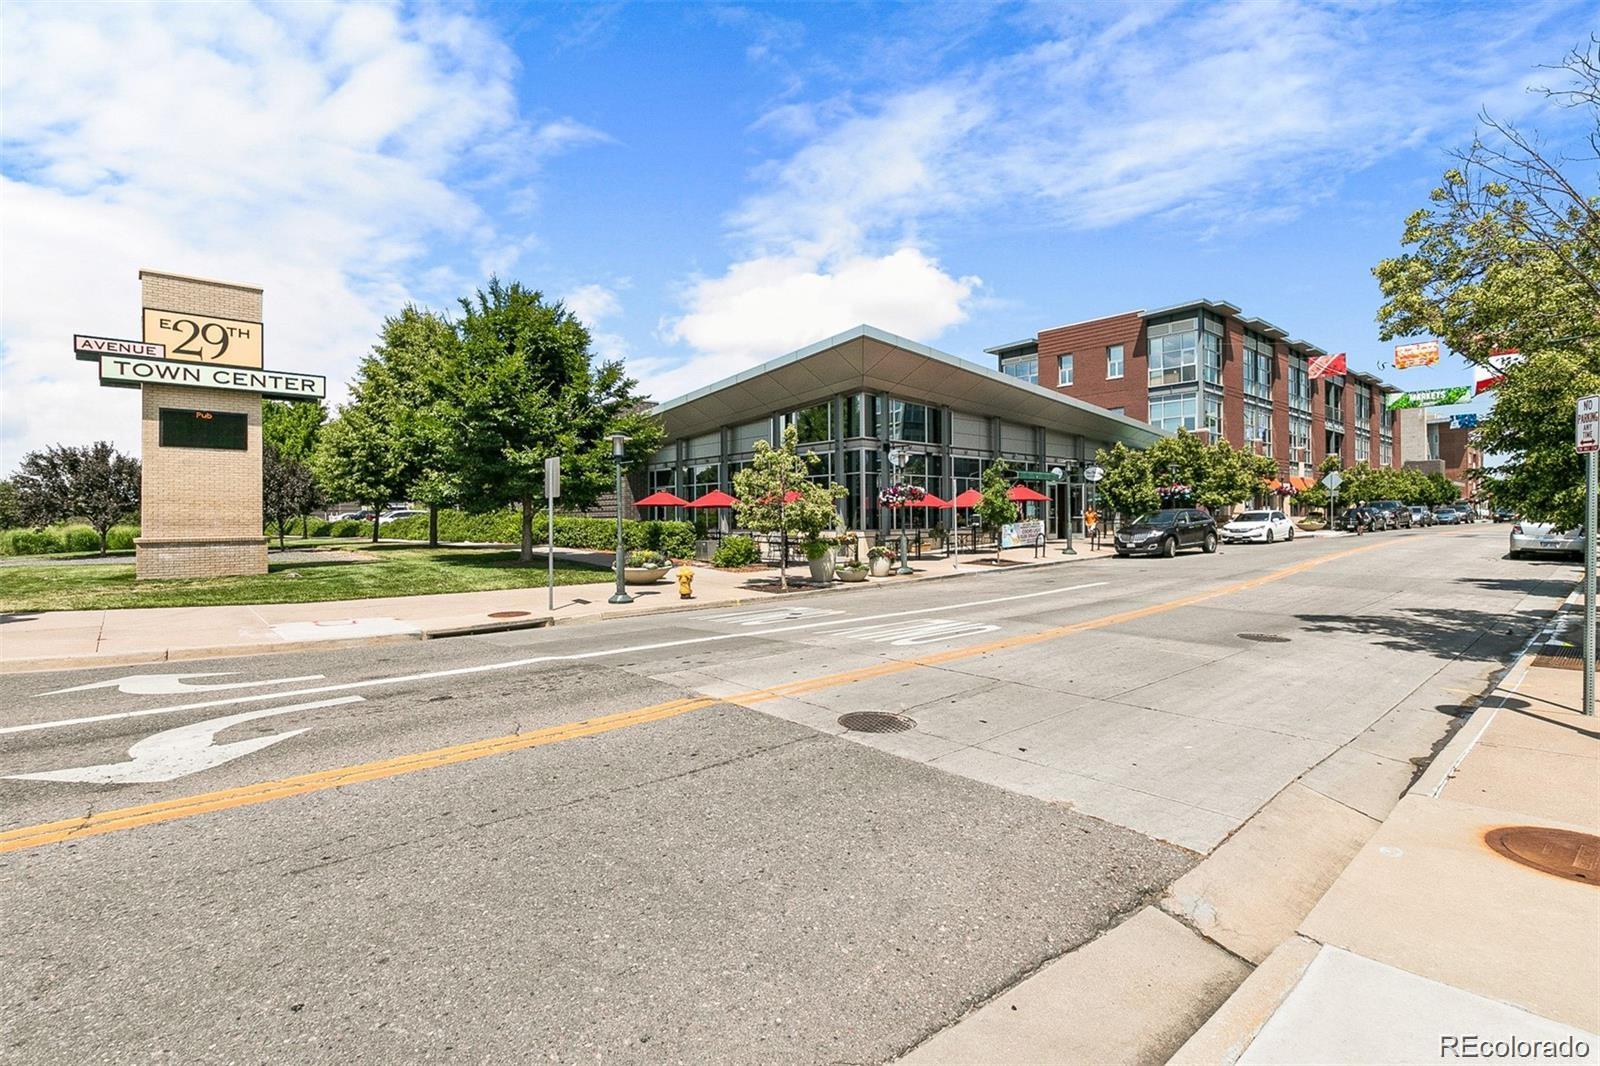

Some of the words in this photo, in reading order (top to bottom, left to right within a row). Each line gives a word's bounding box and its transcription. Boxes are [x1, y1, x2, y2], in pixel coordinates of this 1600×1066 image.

[81, 338, 156, 356] AVENUE
[113, 360, 200, 382] TOWN
[213, 370, 316, 393] CENTER
[1409, 391, 1446, 401] MARKETS
[1583, 400, 1592, 411] NO
[196, 411, 213, 420] Pub
[1577, 412, 1598, 424] PARKING
[811, 617, 1002, 646] ONLY
